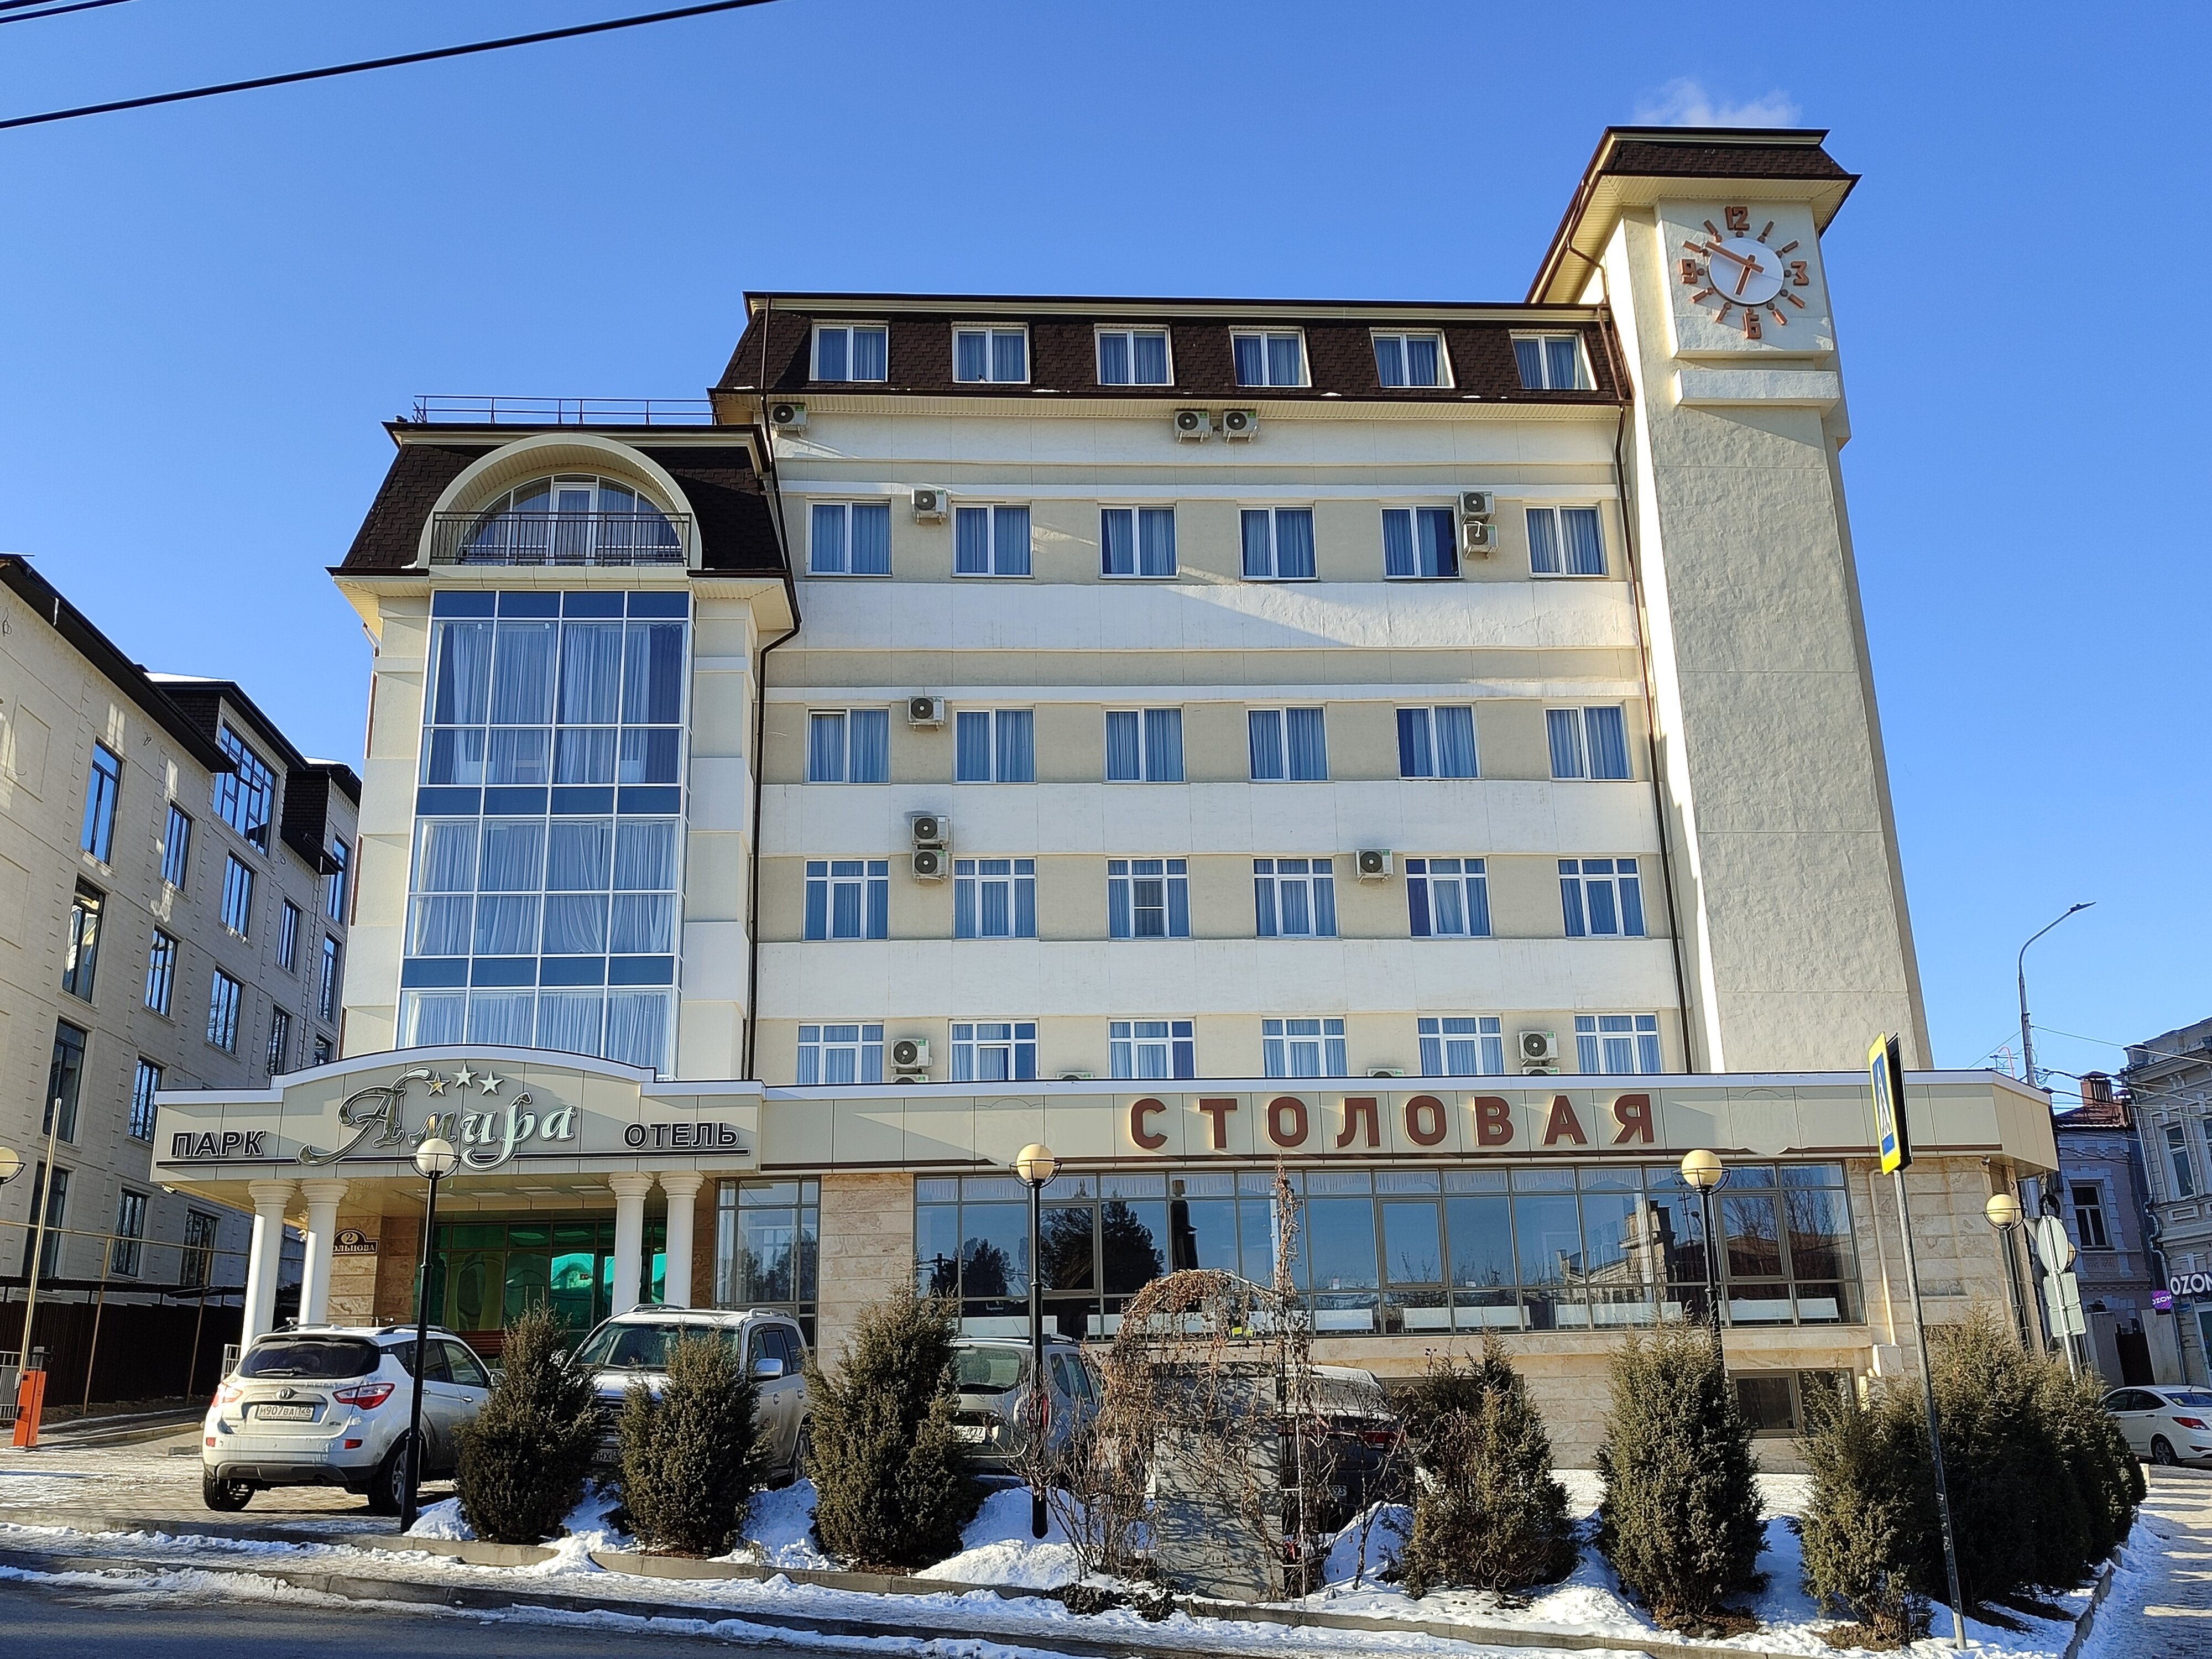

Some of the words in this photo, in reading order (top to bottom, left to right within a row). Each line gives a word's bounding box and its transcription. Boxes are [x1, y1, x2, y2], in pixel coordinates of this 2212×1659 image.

[1725, 206, 1750, 231] 12
[1680, 259, 1698, 284] 9
[1791, 261, 1809, 286] 3
[1744, 314, 1762, 339] 6
[1129, 1093, 1655, 1149] СТОЛОВАЯ
[171, 1130, 267, 1157] ПАРК
[623, 1121, 739, 1148] ОТЕЛЬ
[346, 1233, 353, 1243] 2
